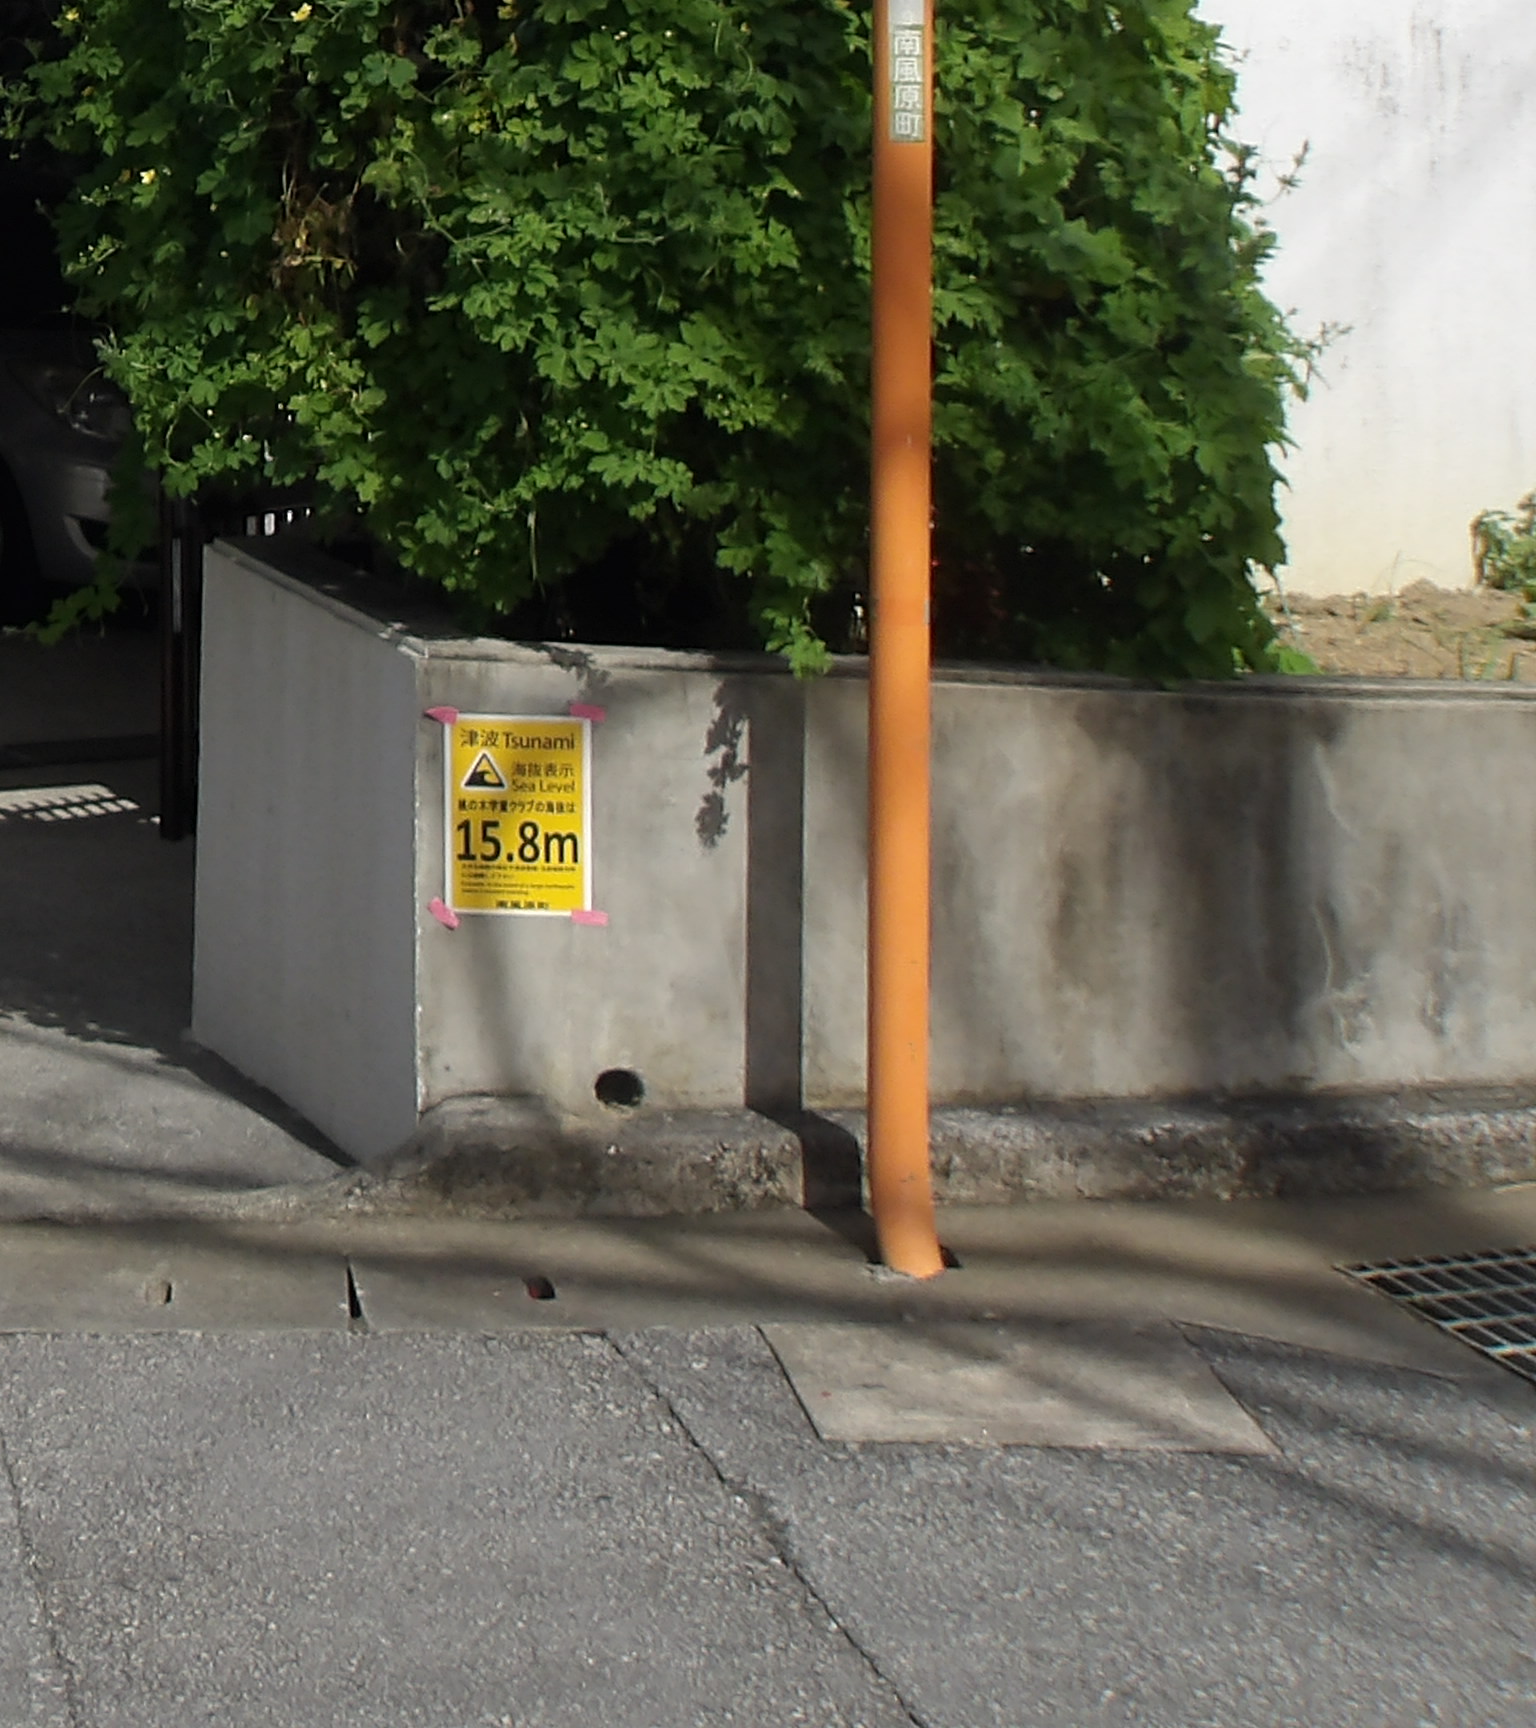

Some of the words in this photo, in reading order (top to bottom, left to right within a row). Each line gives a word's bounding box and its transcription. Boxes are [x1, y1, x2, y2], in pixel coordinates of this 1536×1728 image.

[893, 30, 923, 138] 南風原町
[460, 728, 500, 747] 津波
[503, 731, 576, 750] Tsunami
[512, 778, 536, 792] Sea
[539, 779, 576, 794] Level
[456, 818, 579, 864] 15.8m
